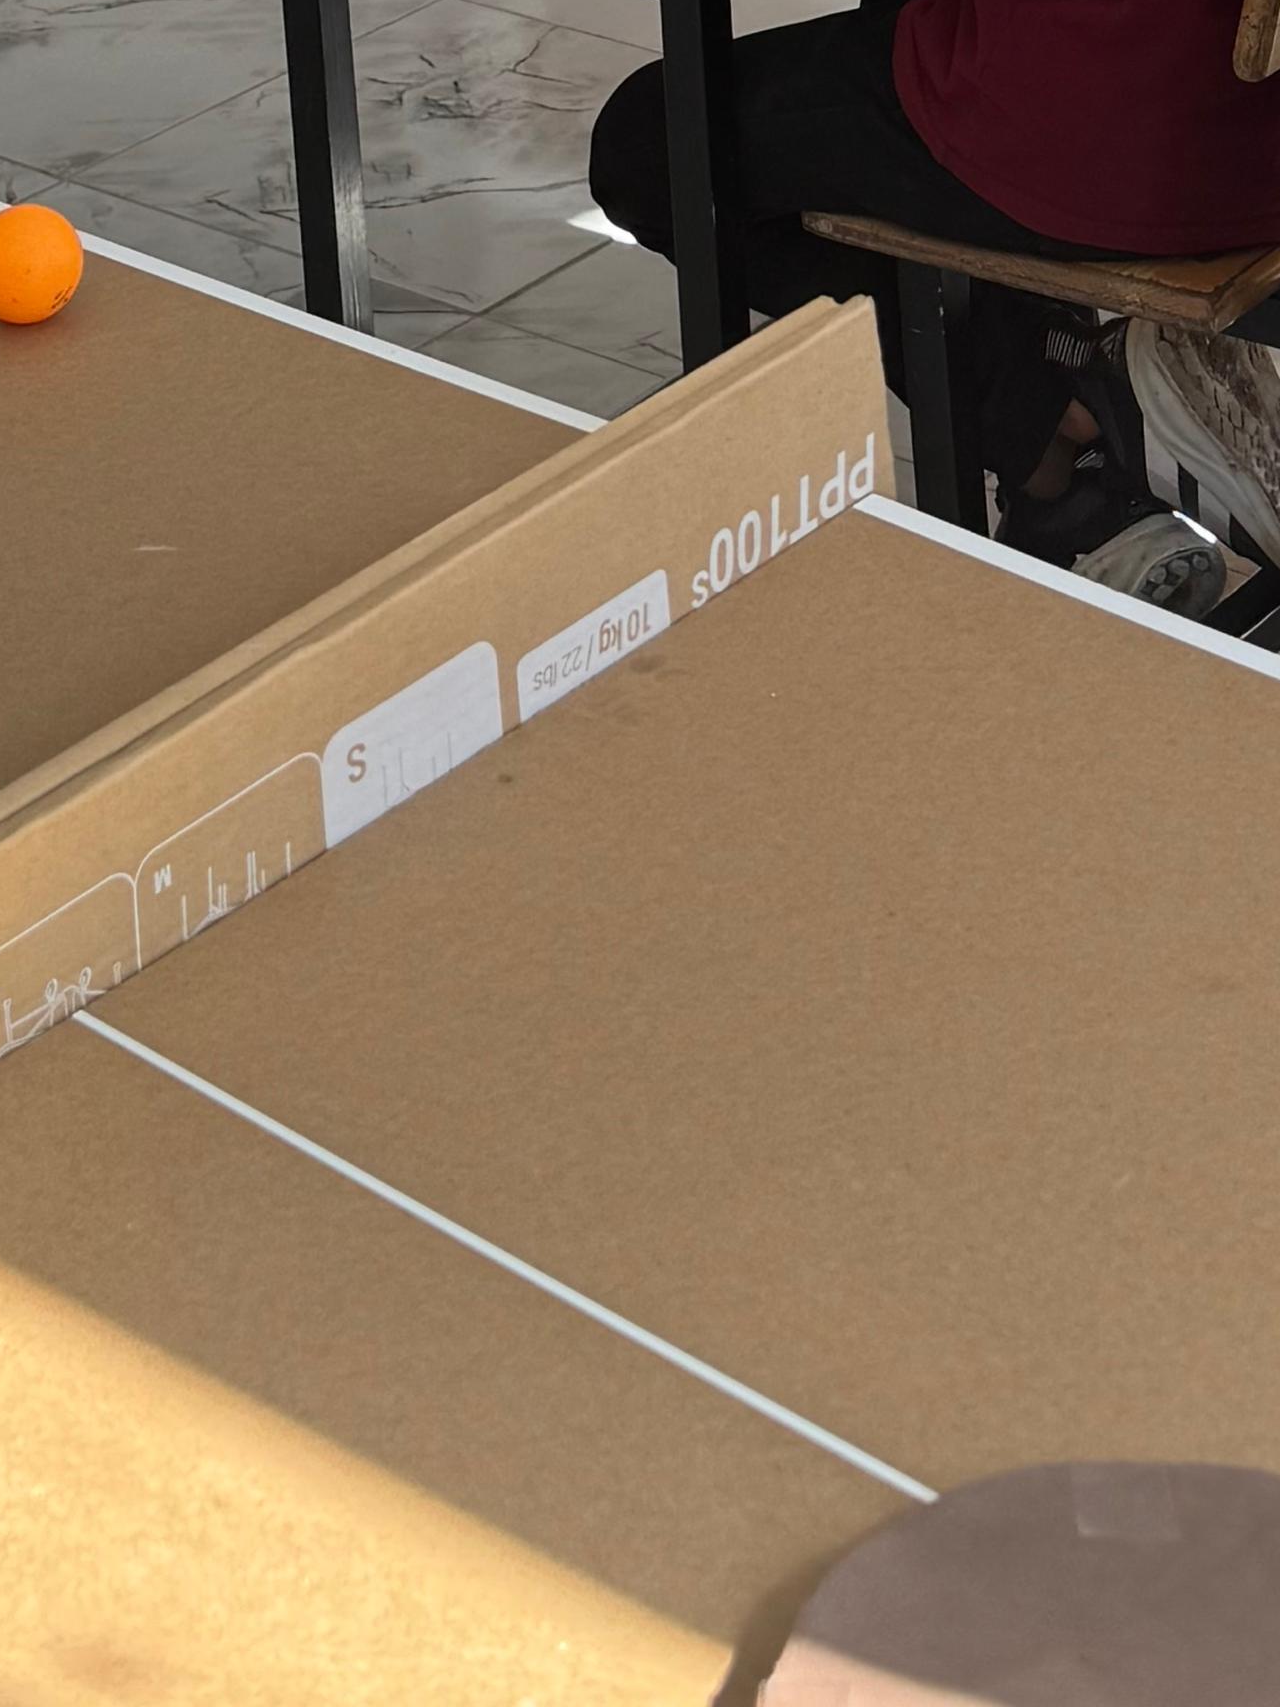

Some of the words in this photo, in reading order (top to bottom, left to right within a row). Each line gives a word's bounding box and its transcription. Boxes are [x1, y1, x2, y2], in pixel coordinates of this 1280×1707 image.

[599, 618, 623, 654] kg
[627, 601, 651, 642] 10
[532, 661, 557, 692] lbs
[562, 644, 584, 678] 22
[347, 742, 366, 784] S
[154, 863, 173, 895] M
